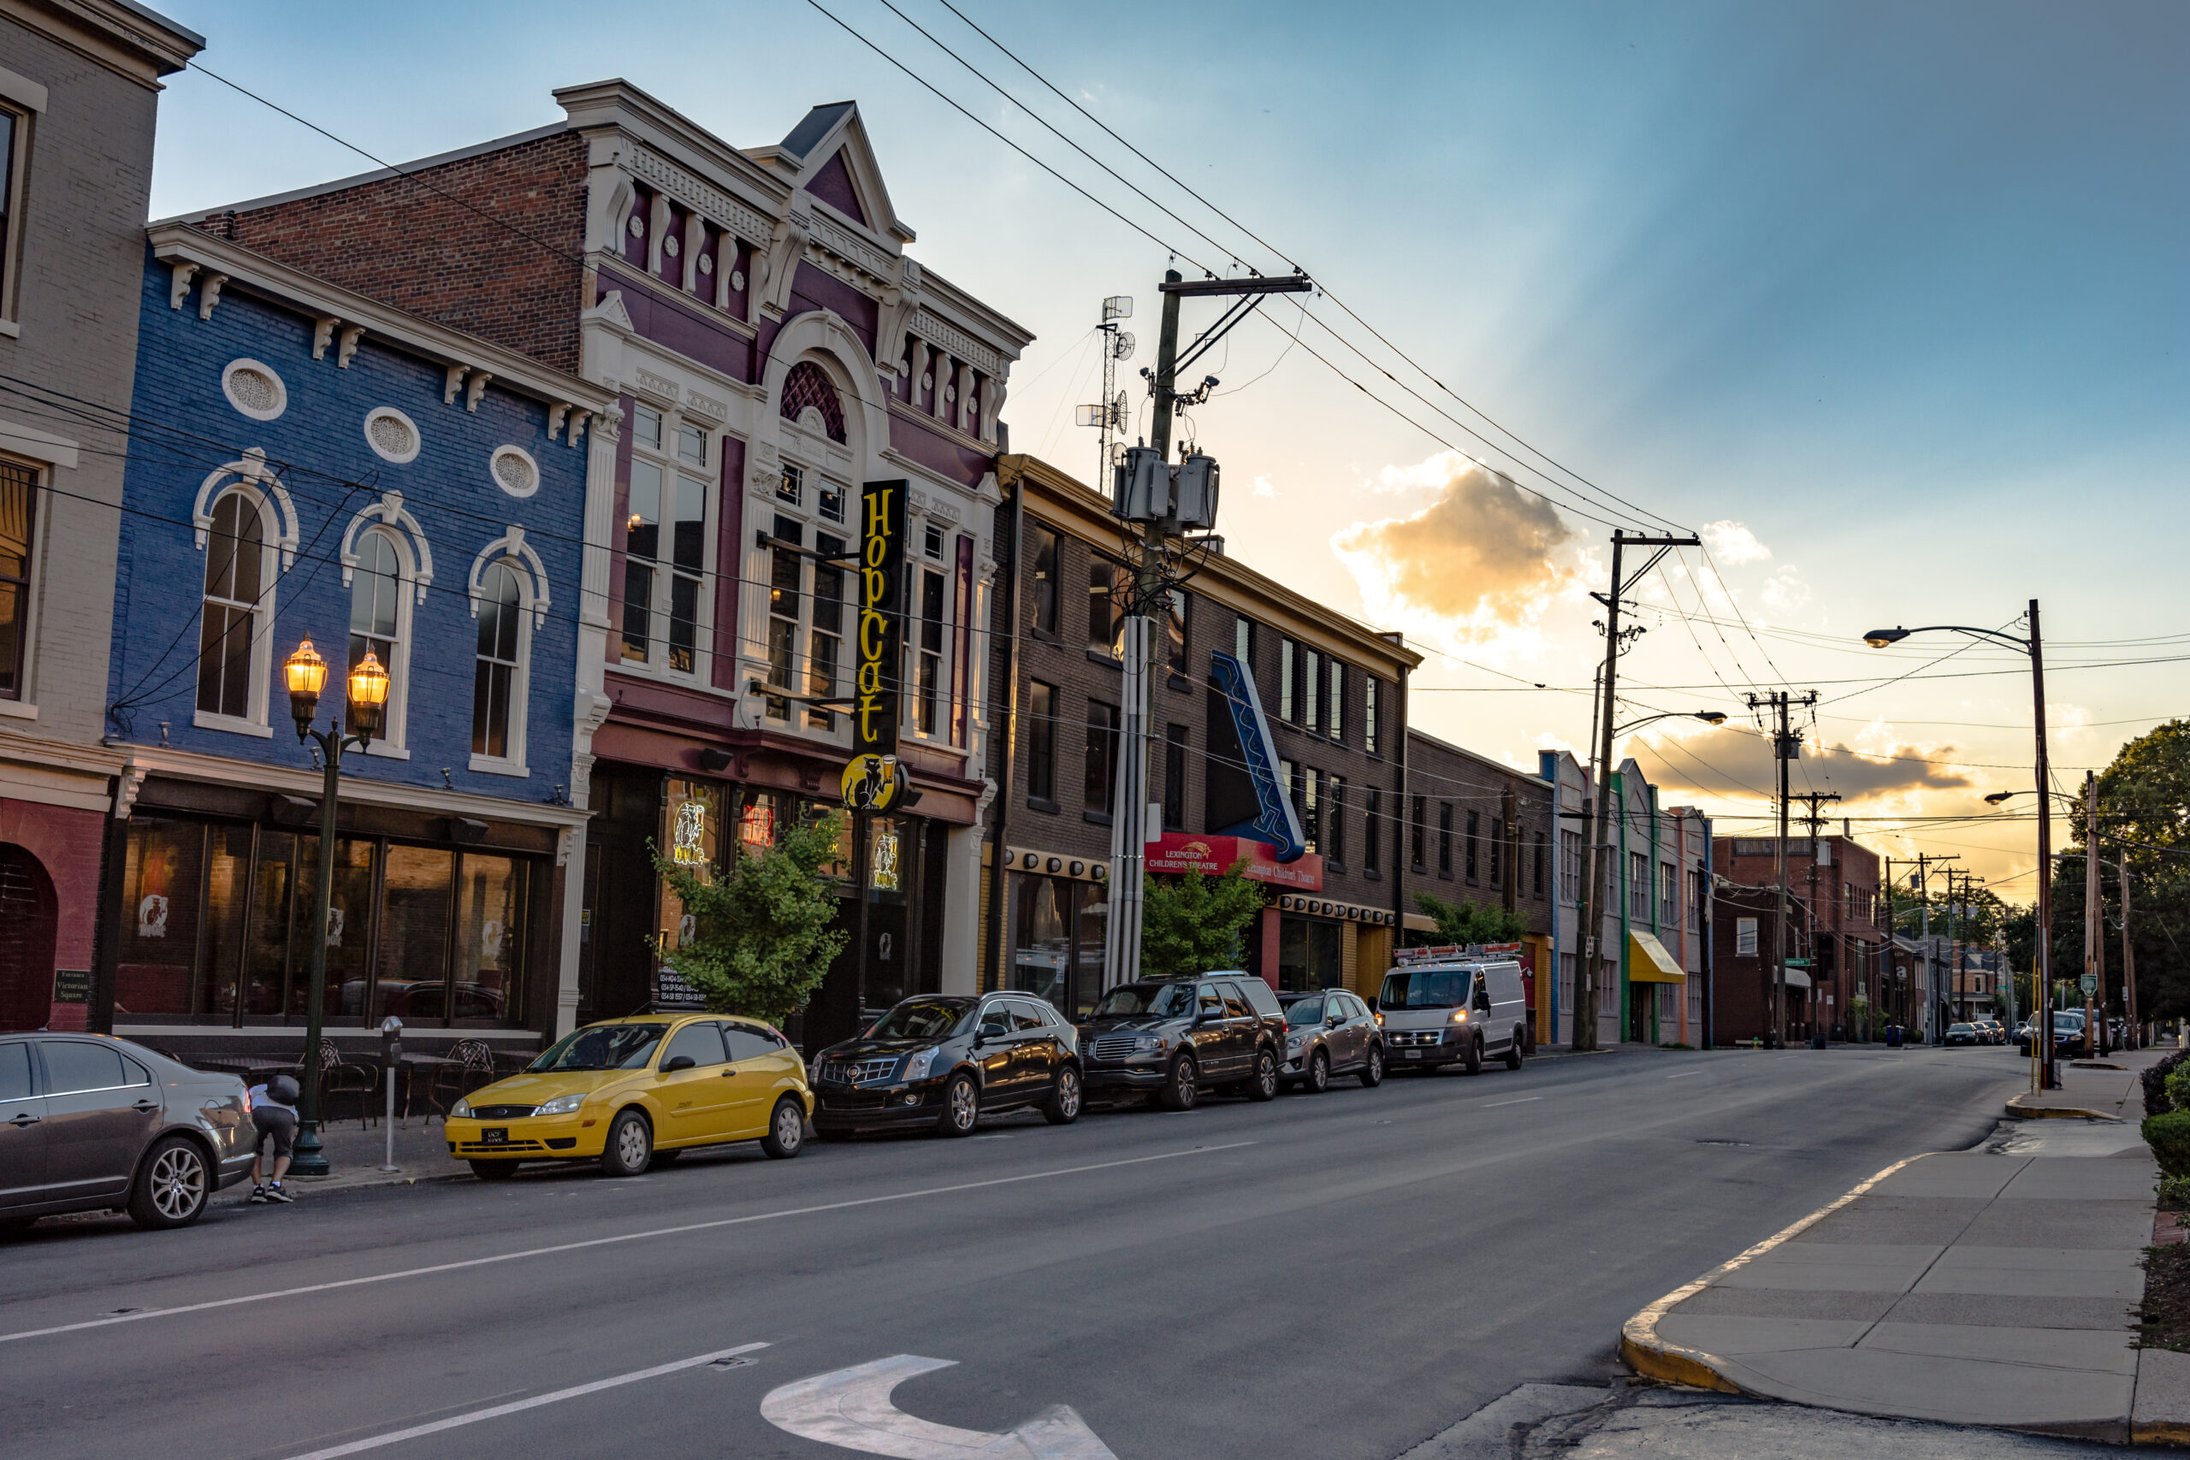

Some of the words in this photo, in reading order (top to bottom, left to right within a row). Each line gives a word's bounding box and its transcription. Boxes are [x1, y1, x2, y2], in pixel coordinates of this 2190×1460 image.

[1165, 850, 1203, 859] LEXINGTON
[57, 981, 89, 990] Victorian
[61, 991, 82, 1000] Square
